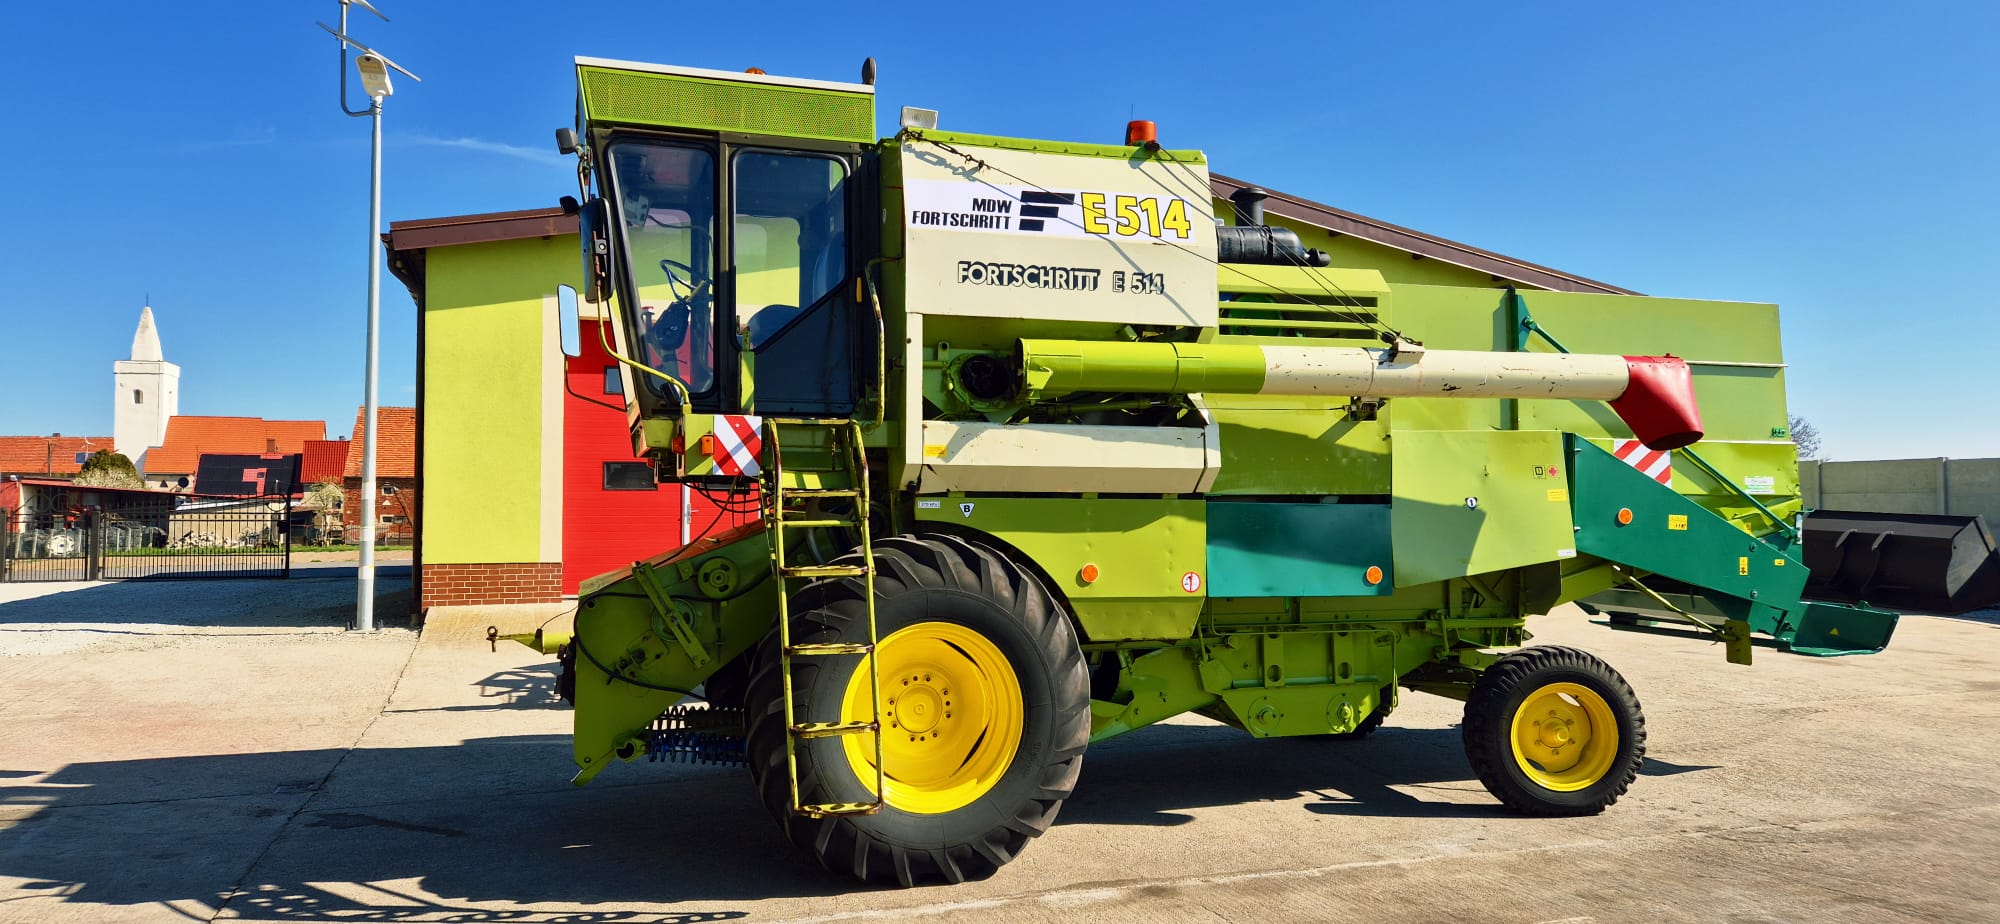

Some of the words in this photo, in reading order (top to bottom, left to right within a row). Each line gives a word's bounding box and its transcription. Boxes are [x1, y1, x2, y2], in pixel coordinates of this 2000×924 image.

[972, 198, 1012, 213] MDW
[912, 210, 1011, 229] FORTSCHRITT
[1081, 192, 1109, 234] E
[1116, 195, 1191, 239] 514
[957, 261, 1101, 291] FORTSCHRITT
[1112, 271, 1125, 293] E
[1131, 272, 1164, 295] 514
[963, 504, 971, 513] B
